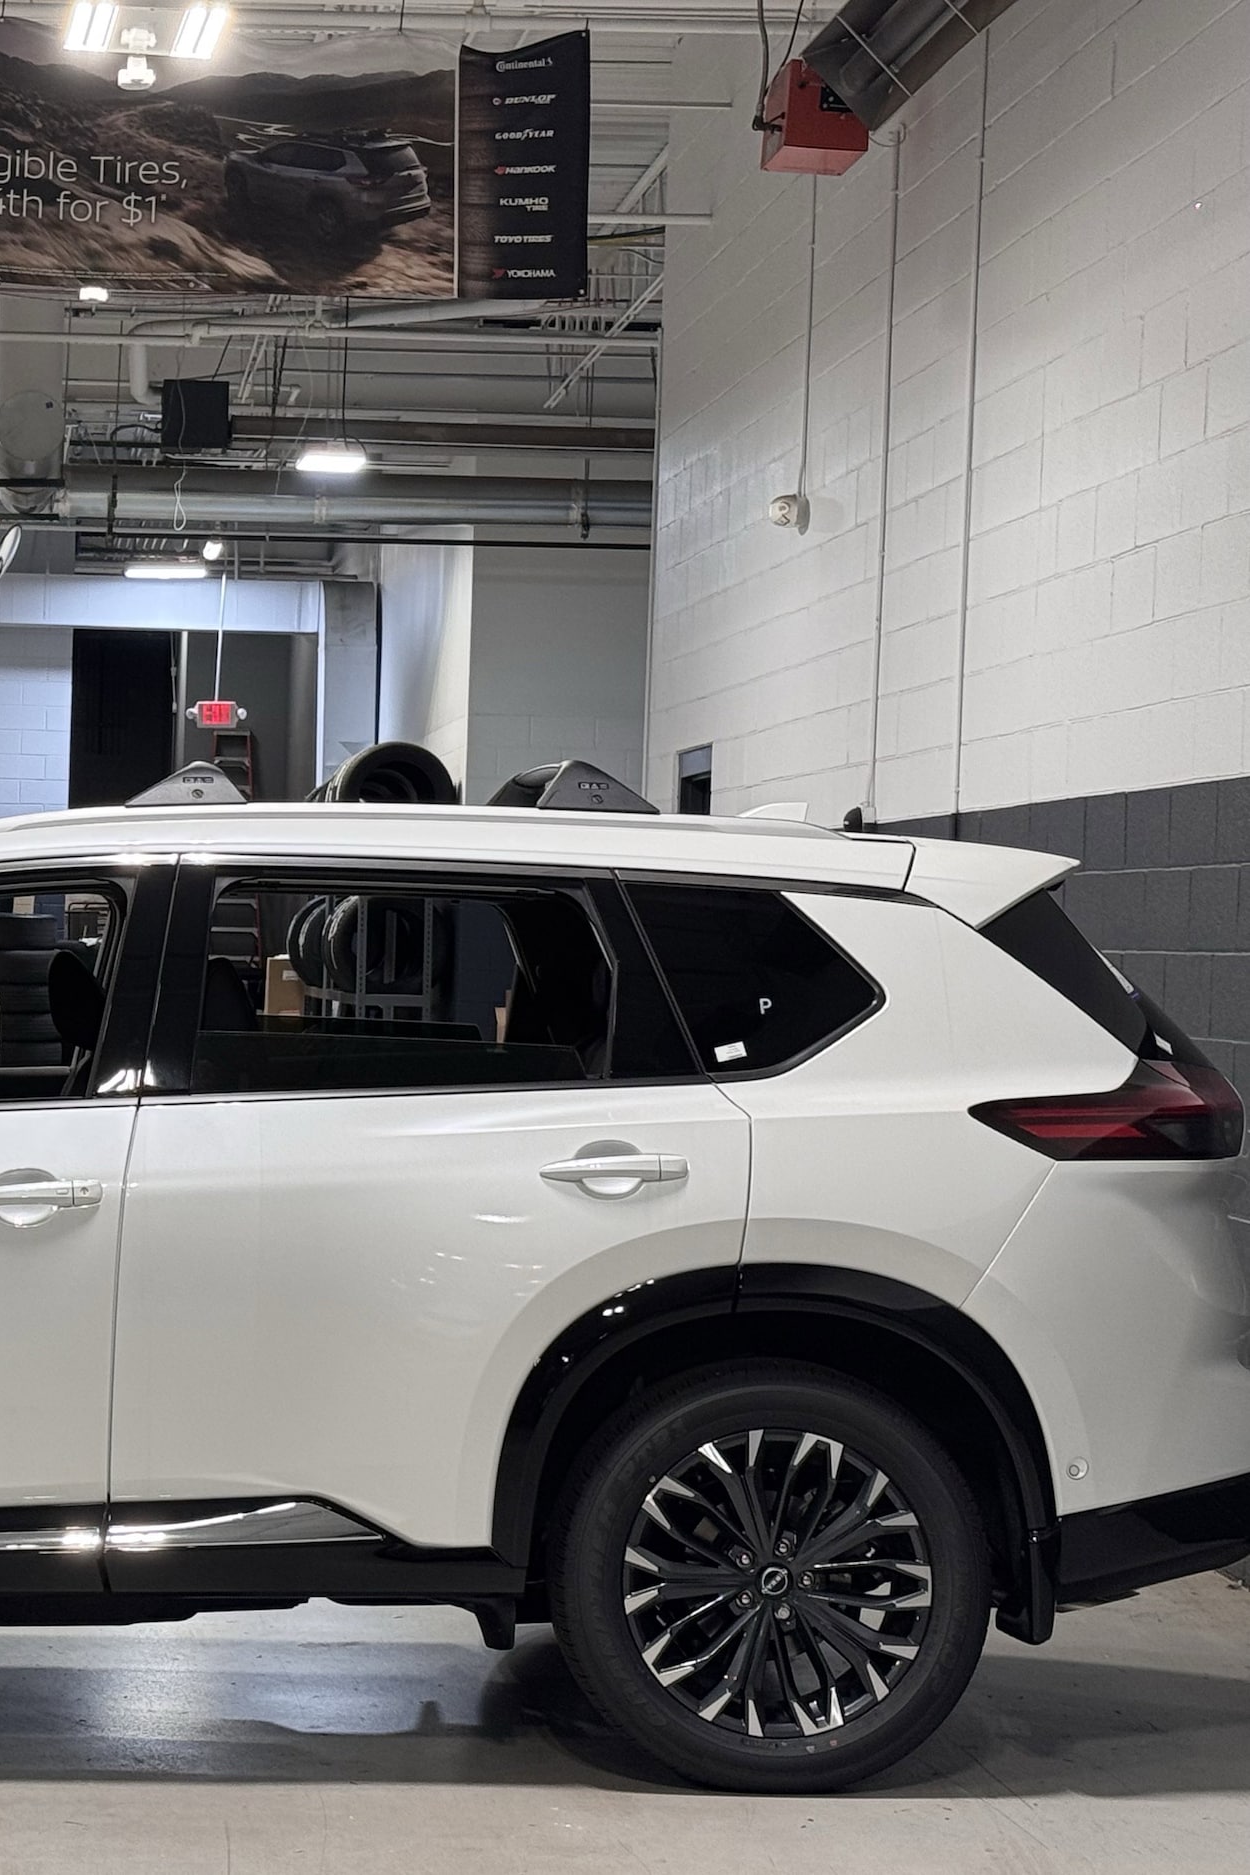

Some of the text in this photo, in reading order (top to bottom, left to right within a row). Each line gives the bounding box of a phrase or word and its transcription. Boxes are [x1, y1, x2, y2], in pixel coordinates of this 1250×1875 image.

[496, 58, 546, 72] Continental
[505, 94, 557, 105] DUNLOP
[495, 129, 554, 140] GOODYEAR
[91, 155, 188, 189] Tires,
[56, 190, 109, 223] for
[499, 197, 548, 206] KUMHO
[494, 235, 522, 243] TOYO
[507, 269, 556, 278] YOKOHAMA
[759, 998, 772, 1014] P
